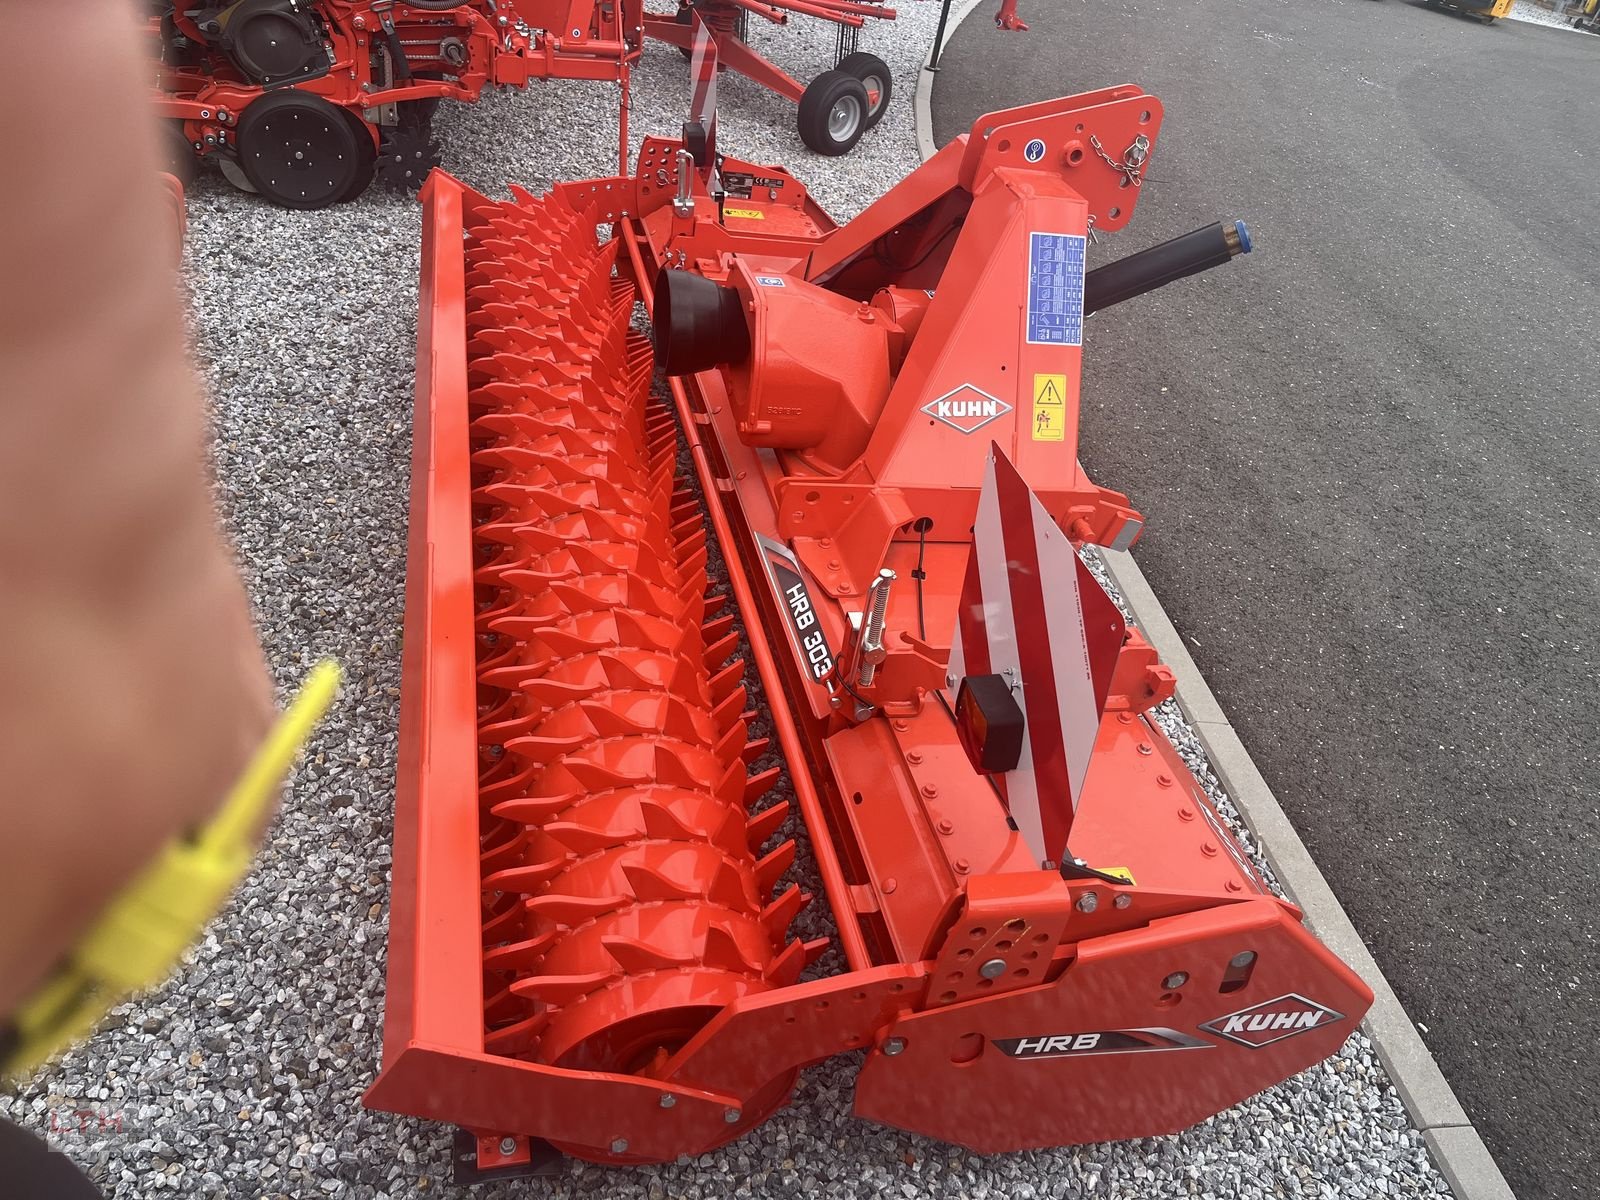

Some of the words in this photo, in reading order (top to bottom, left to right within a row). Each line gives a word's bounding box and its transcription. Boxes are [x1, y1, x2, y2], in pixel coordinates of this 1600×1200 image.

[938, 400, 997, 417] KUHN
[785, 583, 815, 631] HRB
[803, 630, 834, 679] 303
[1221, 1010, 1325, 1034] KUHN
[1014, 1032, 1102, 1056] HRB
